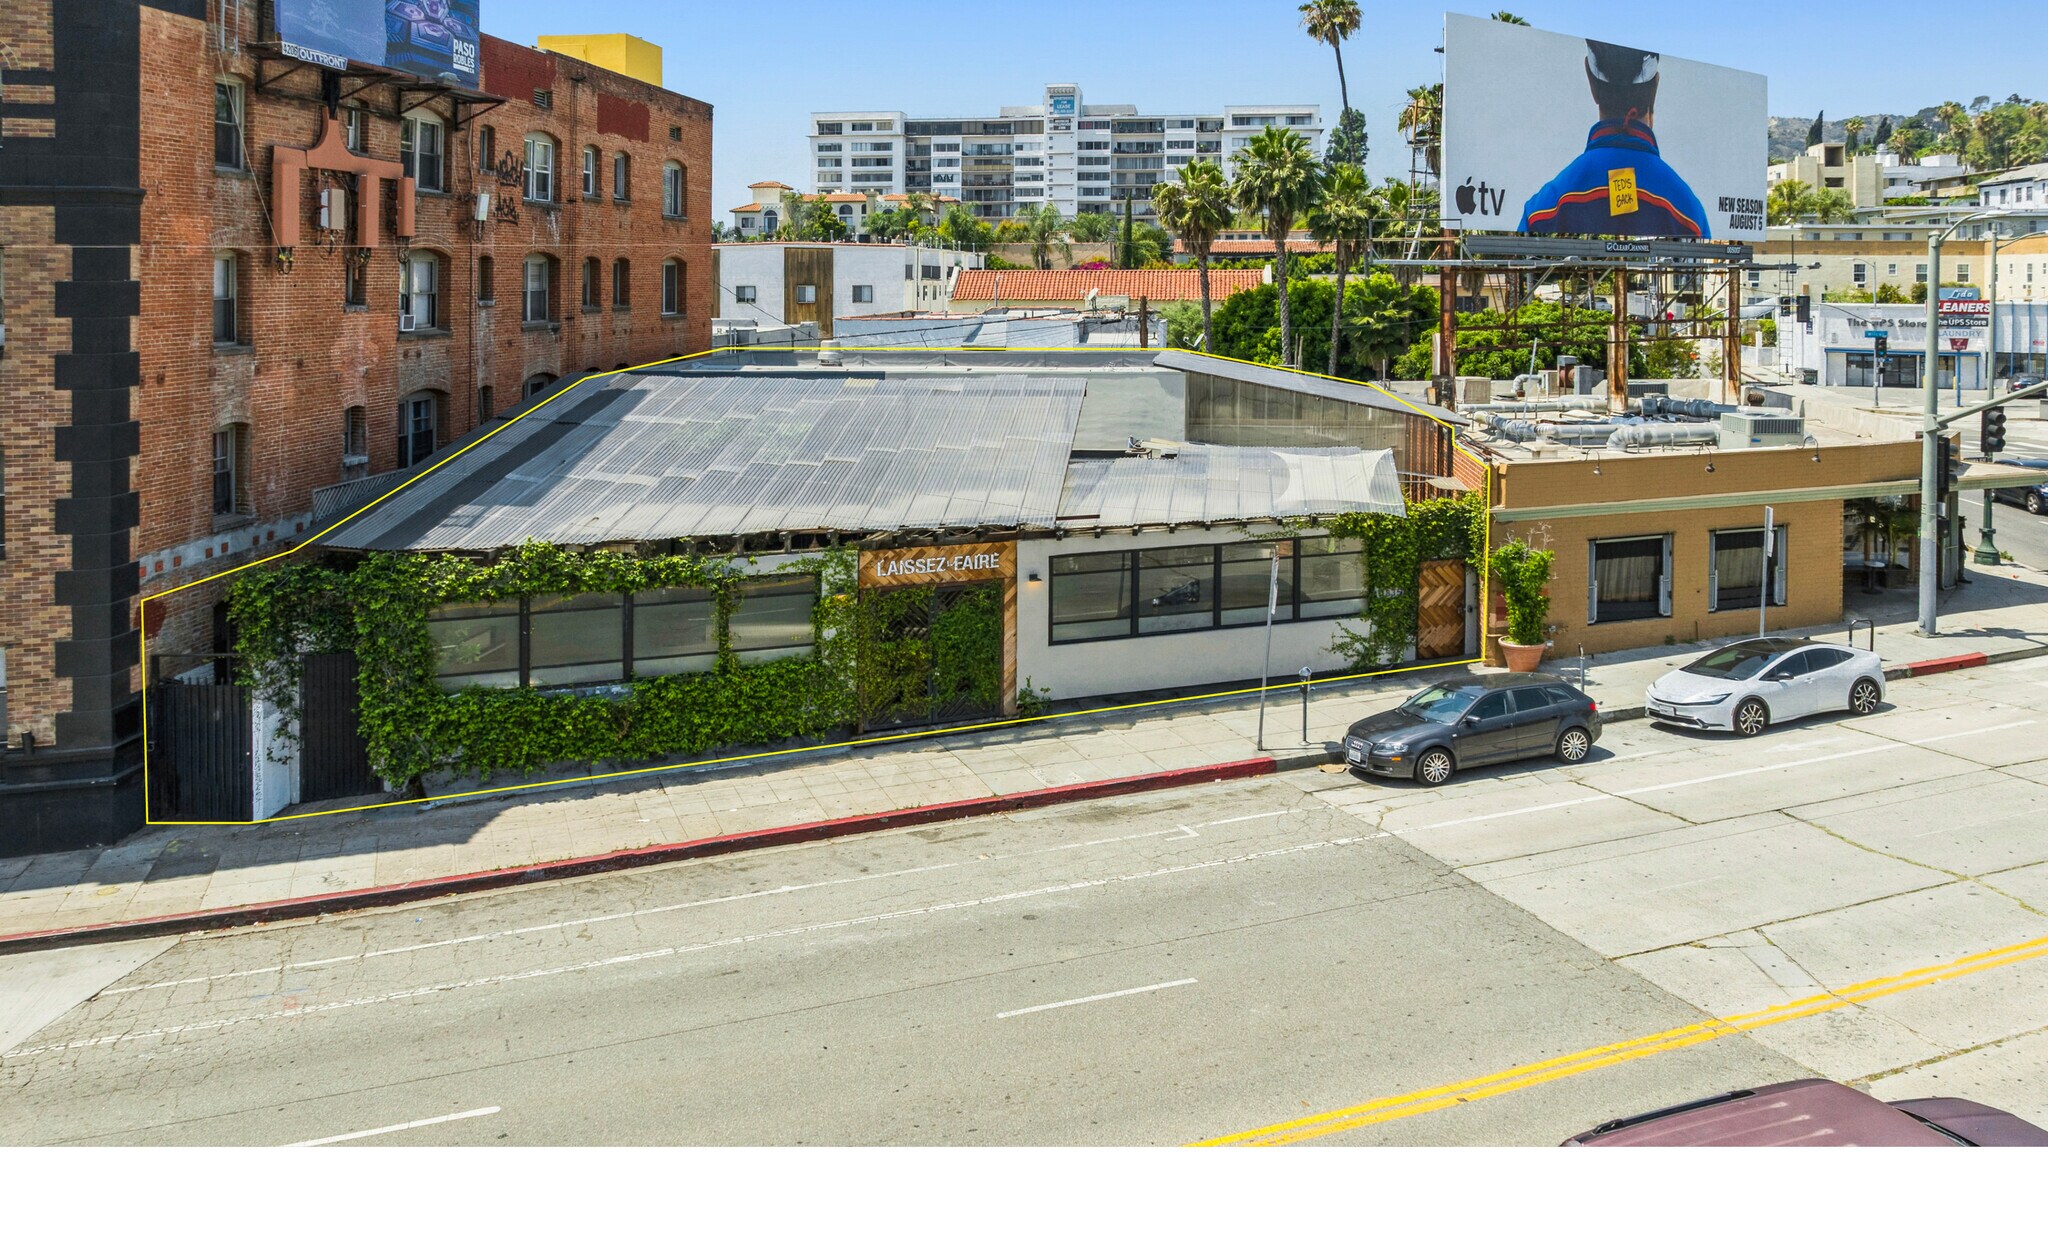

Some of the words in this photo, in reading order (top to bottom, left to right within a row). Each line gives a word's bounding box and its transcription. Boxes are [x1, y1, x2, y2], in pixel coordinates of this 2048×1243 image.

[453, 39, 475, 58] PASO
[299, 48, 346, 68] OUTFRONT
[453, 54, 475, 68] ROBLES
[1613, 178, 1632, 191] TED'S
[1478, 181, 1506, 217] tv
[1616, 193, 1634, 208] BACK
[1718, 196, 1735, 212] NEW
[1736, 199, 1763, 215] SEASON
[1729, 214, 1757, 231] AUGUST
[1757, 216, 1763, 231] 5
[1947, 289, 1973, 299] Lido
[1938, 302, 1991, 313] LEANERS
[1898, 319, 1927, 328] Store
